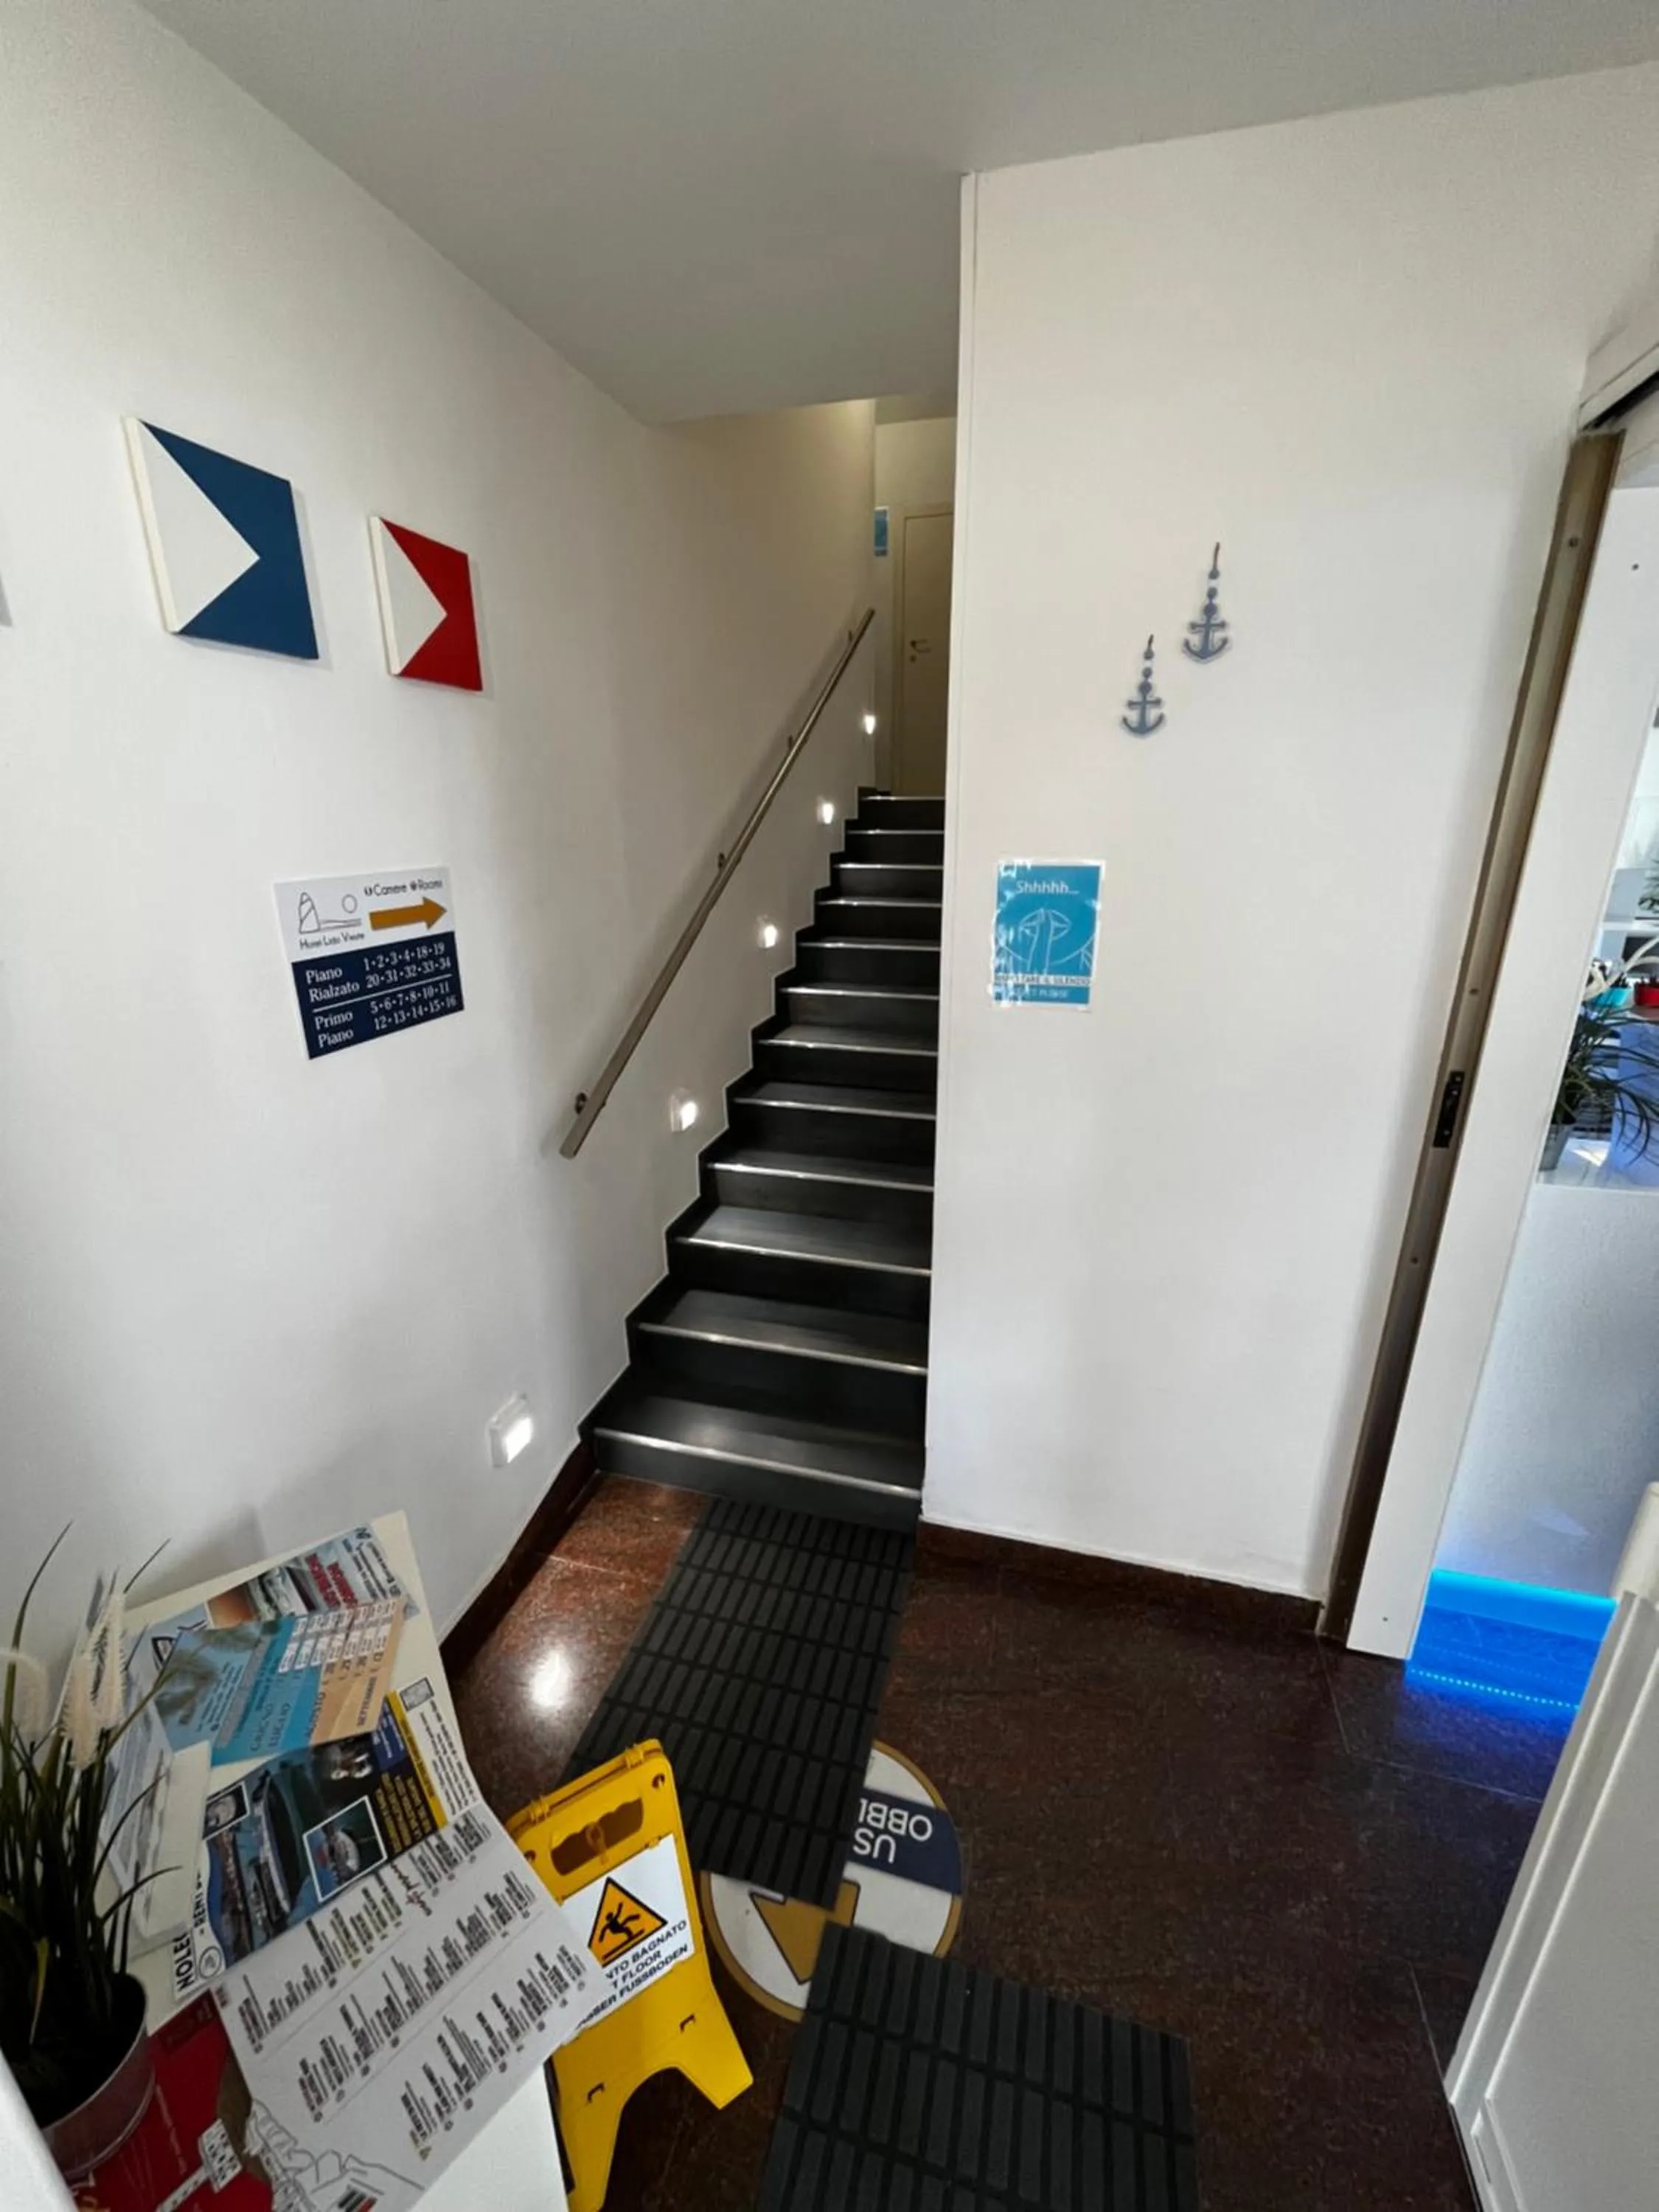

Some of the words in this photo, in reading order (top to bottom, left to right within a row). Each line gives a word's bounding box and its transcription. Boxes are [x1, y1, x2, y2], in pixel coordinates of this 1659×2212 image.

[306, 966, 342, 984] Piano
[308, 981, 360, 1003] Rialzato
[314, 1010, 353, 1030] Primo
[318, 1028, 354, 1048] Piano
[631, 1920, 686, 1963] BAGNATO
[619, 1944, 688, 1997] FUSSBODEN
[622, 1950, 661, 1983] FLOOR
